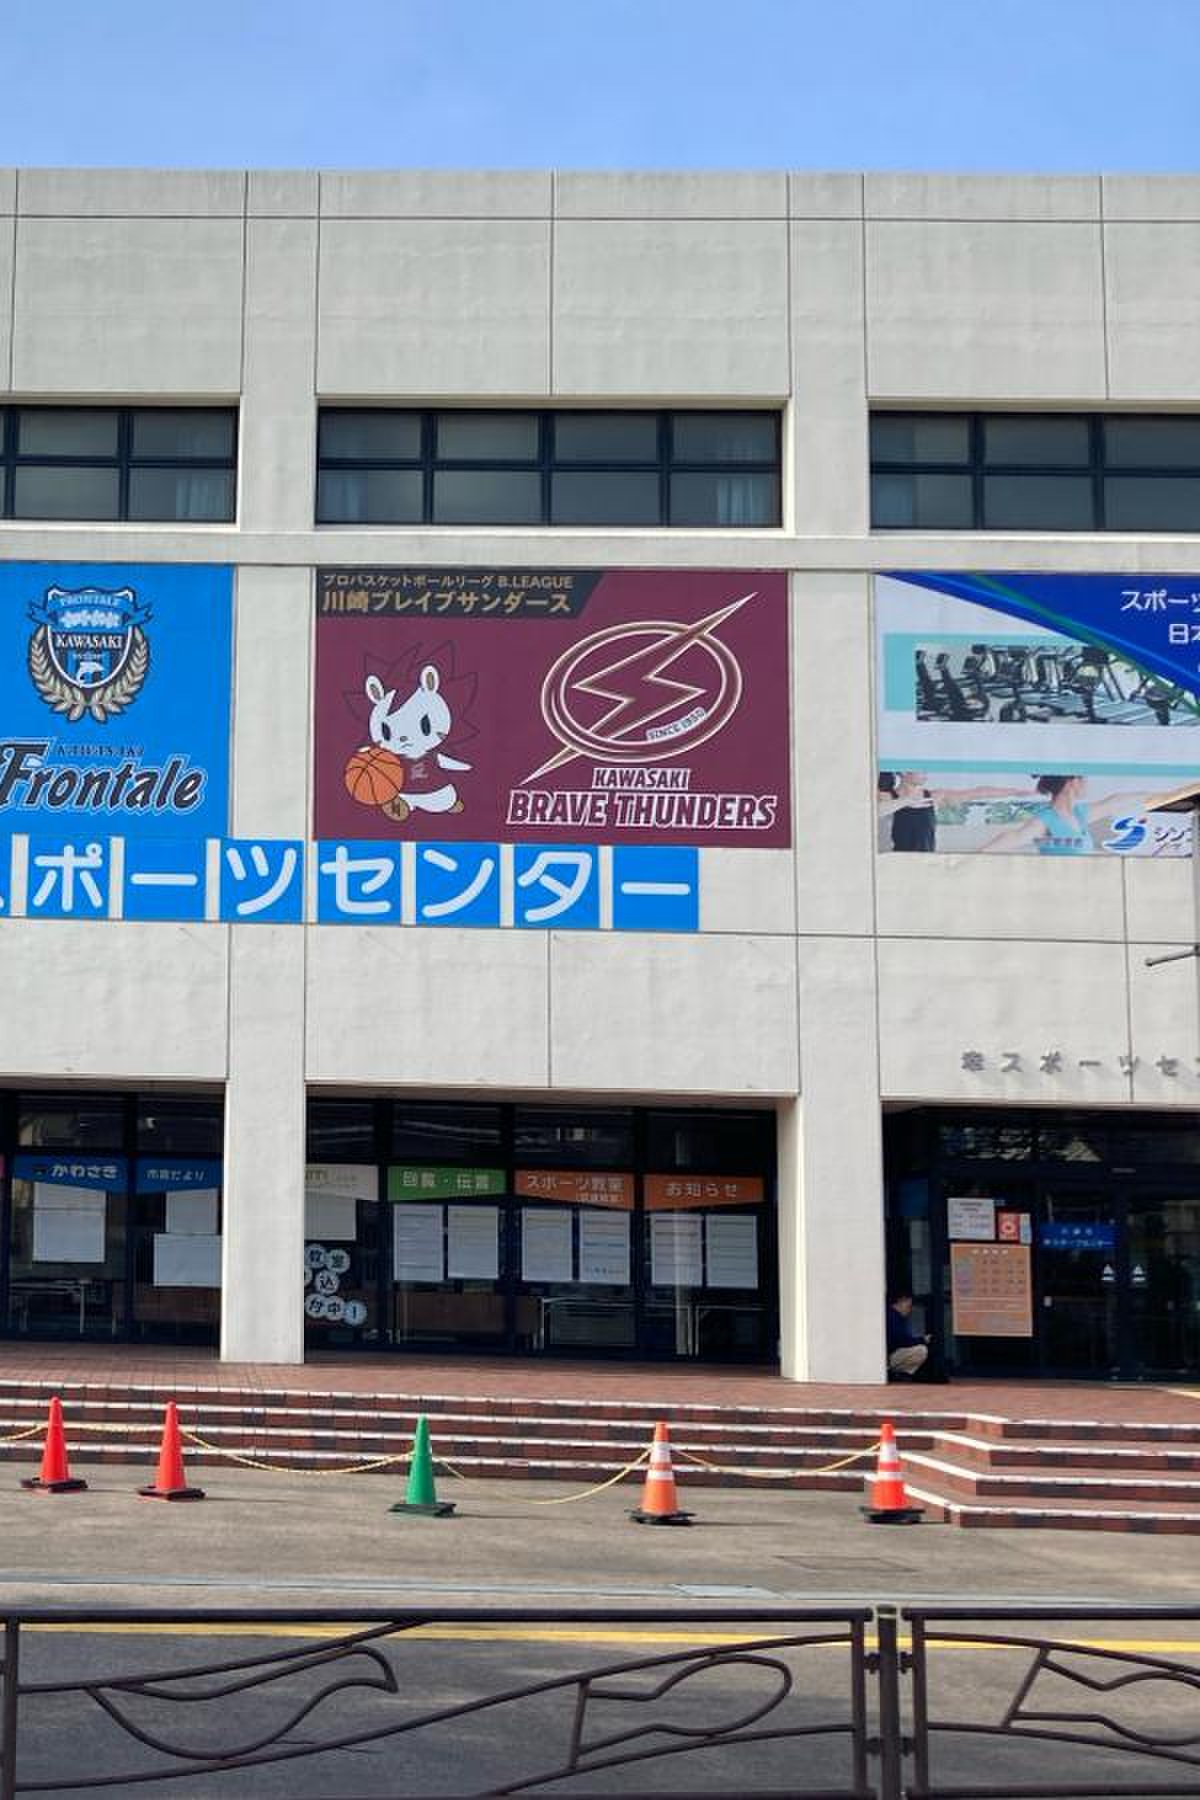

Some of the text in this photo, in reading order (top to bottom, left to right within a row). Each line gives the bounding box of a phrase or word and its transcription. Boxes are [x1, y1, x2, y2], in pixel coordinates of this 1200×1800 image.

[497, 576, 574, 589] B.LEAGUE
[56, 634, 122, 649] KAWASAKI
[592, 768, 690, 789] KAWASAKI
[506, 790, 777, 829] BRAVE THUNDERS
[961, 1051, 1200, 1077] 幸スポーツセ
[51, 1164, 118, 1179] かわさき
[664, 1182, 738, 1198] お知らせ
